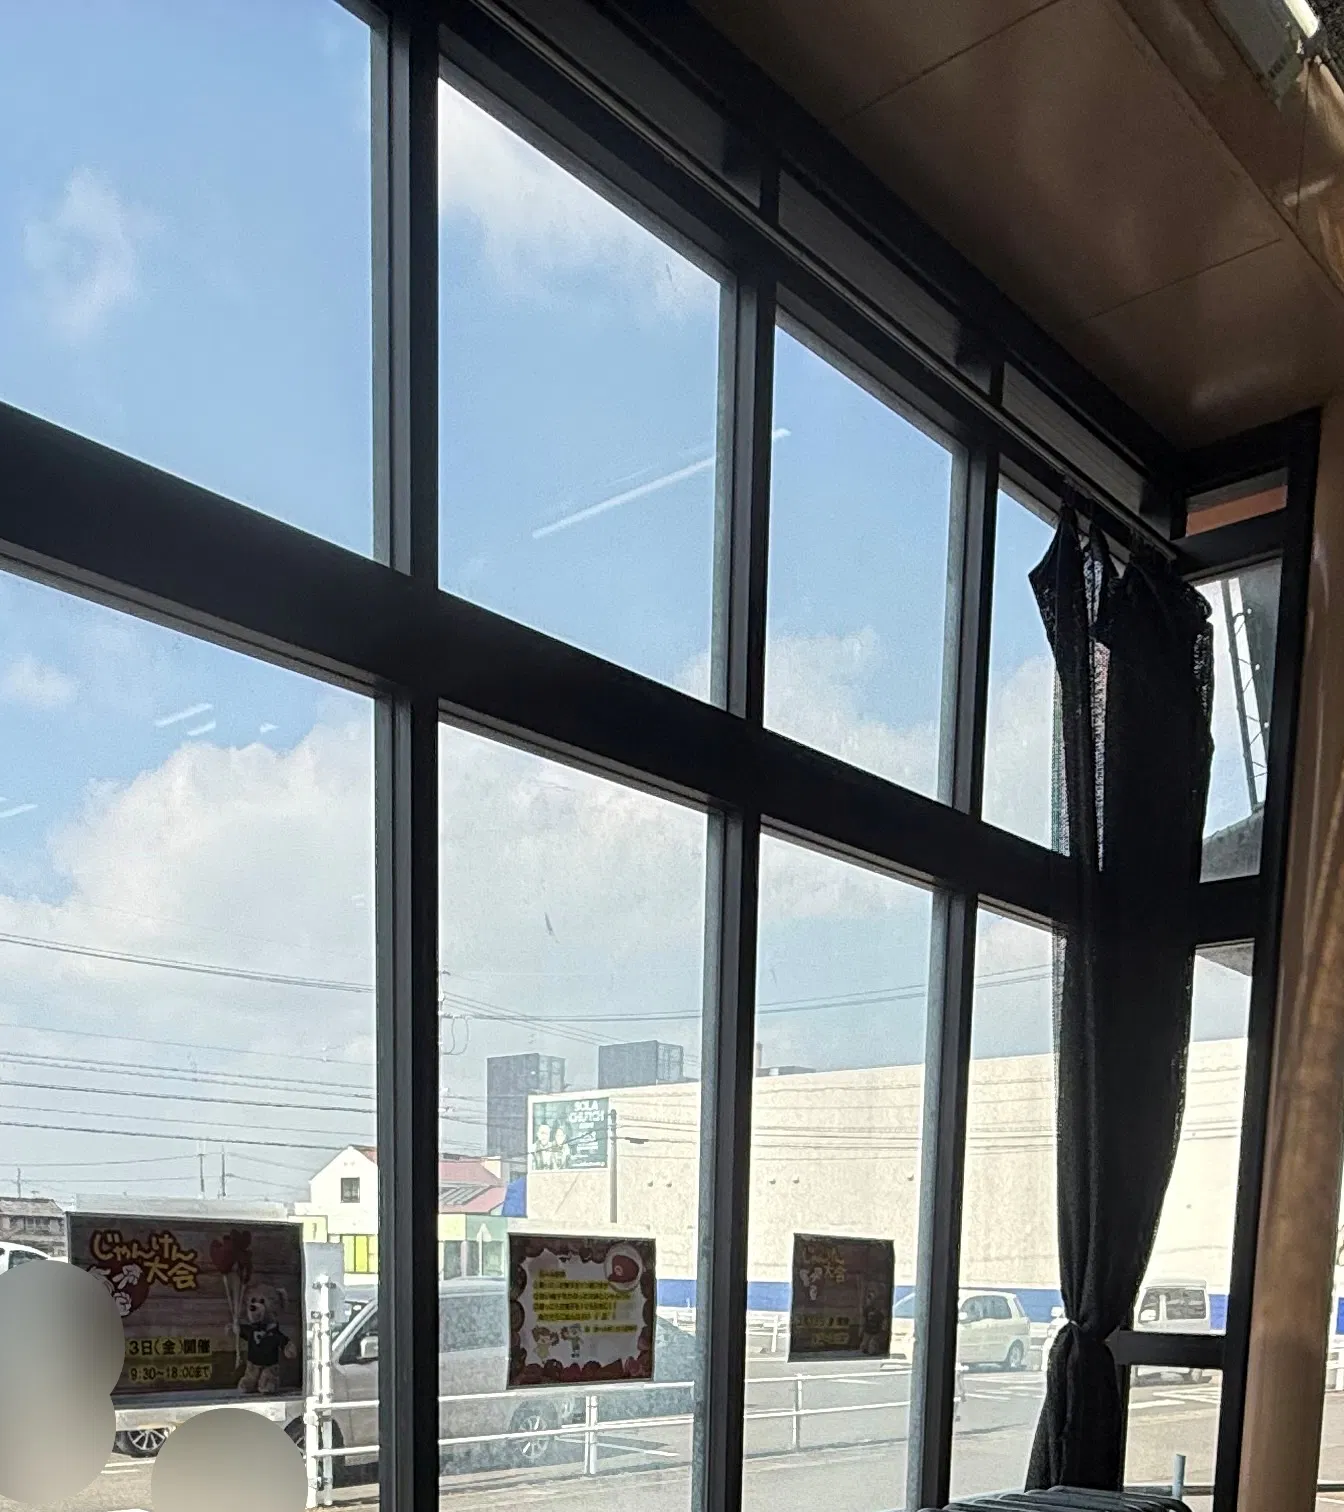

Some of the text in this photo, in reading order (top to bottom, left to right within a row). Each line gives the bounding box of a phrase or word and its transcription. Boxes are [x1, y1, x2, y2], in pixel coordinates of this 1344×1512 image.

[92, 1231, 198, 1262] じゃんけん
[143, 1257, 198, 1290] 大会
